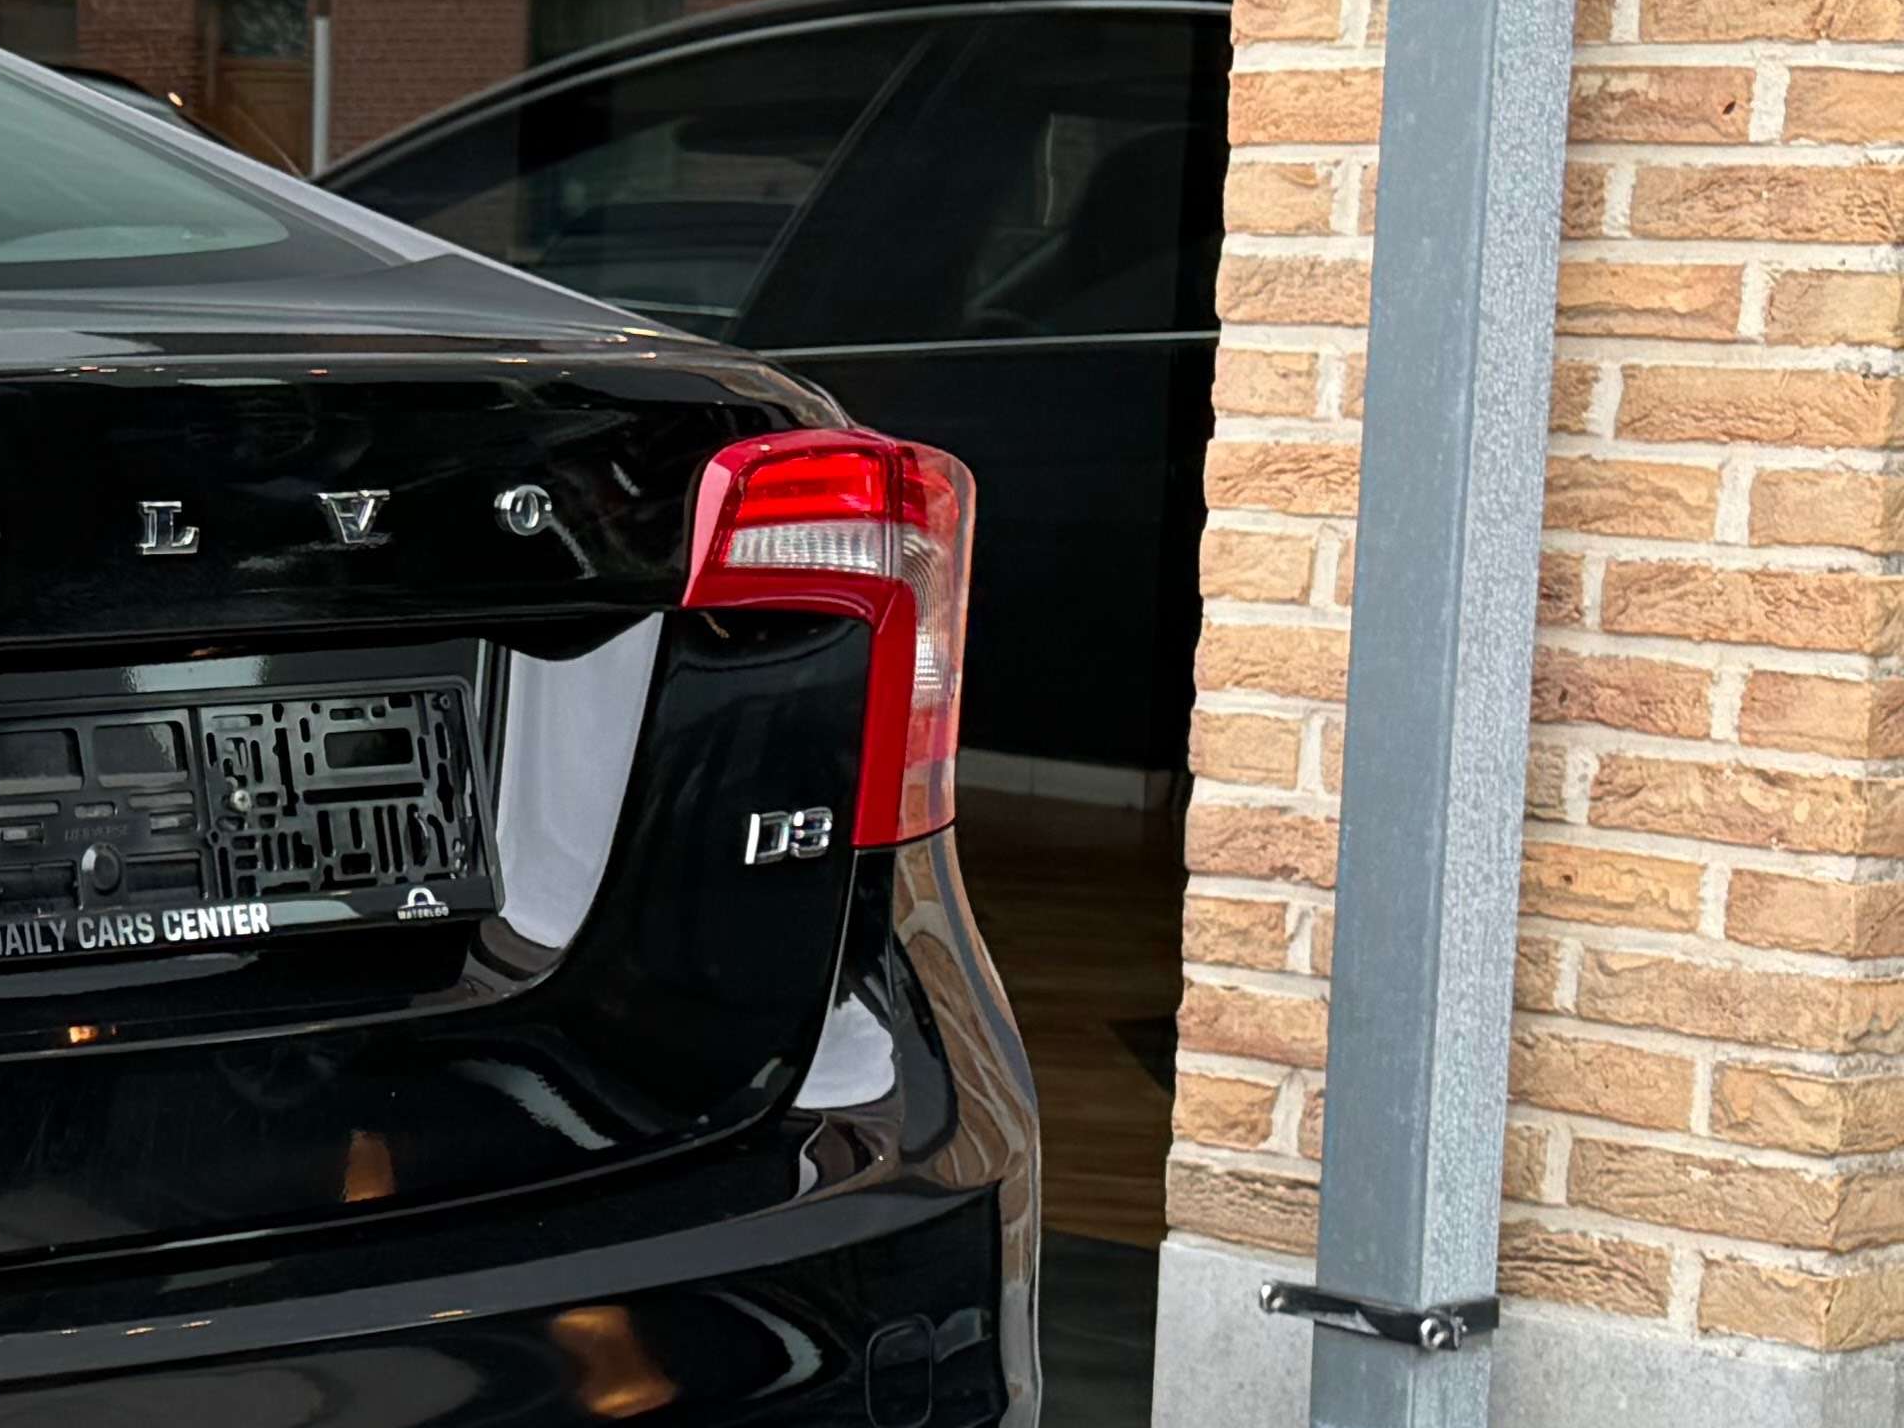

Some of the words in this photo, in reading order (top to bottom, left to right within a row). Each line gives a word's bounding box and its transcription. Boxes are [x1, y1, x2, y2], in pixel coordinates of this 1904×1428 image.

[744, 806, 833, 865] D3
[78, 914, 156, 950] CARS
[162, 903, 271, 943] CENTER
